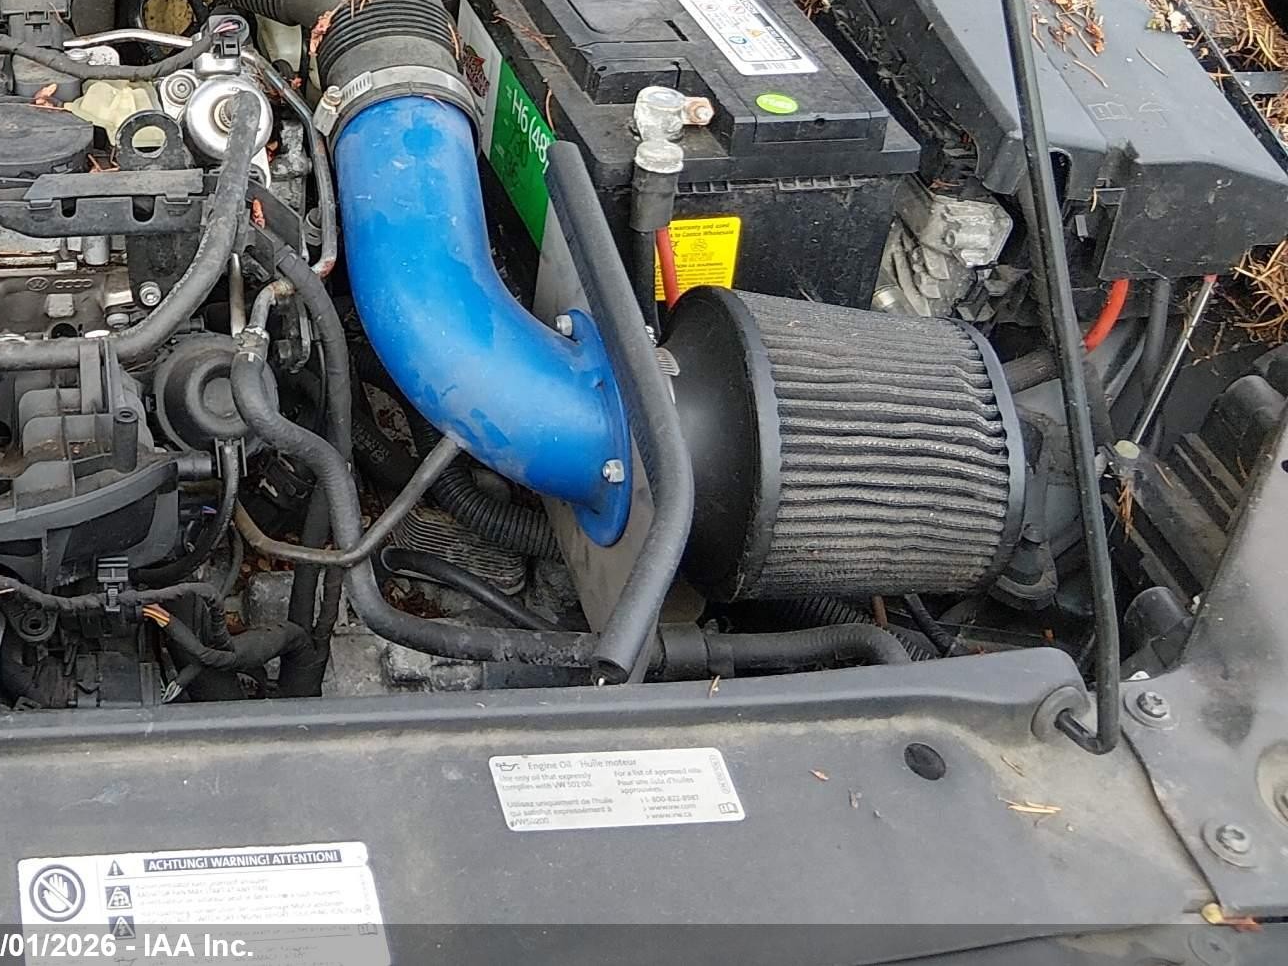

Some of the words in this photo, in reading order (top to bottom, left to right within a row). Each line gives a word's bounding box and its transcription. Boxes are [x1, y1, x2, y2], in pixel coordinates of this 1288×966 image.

[527, 761, 558, 772] Engine
[559, 760, 572, 769] Oil
[148, 857, 210, 872] ACHTUNG!
[210, 855, 271, 868] WARNING!
[271, 850, 339, 866] ATTENTION!
